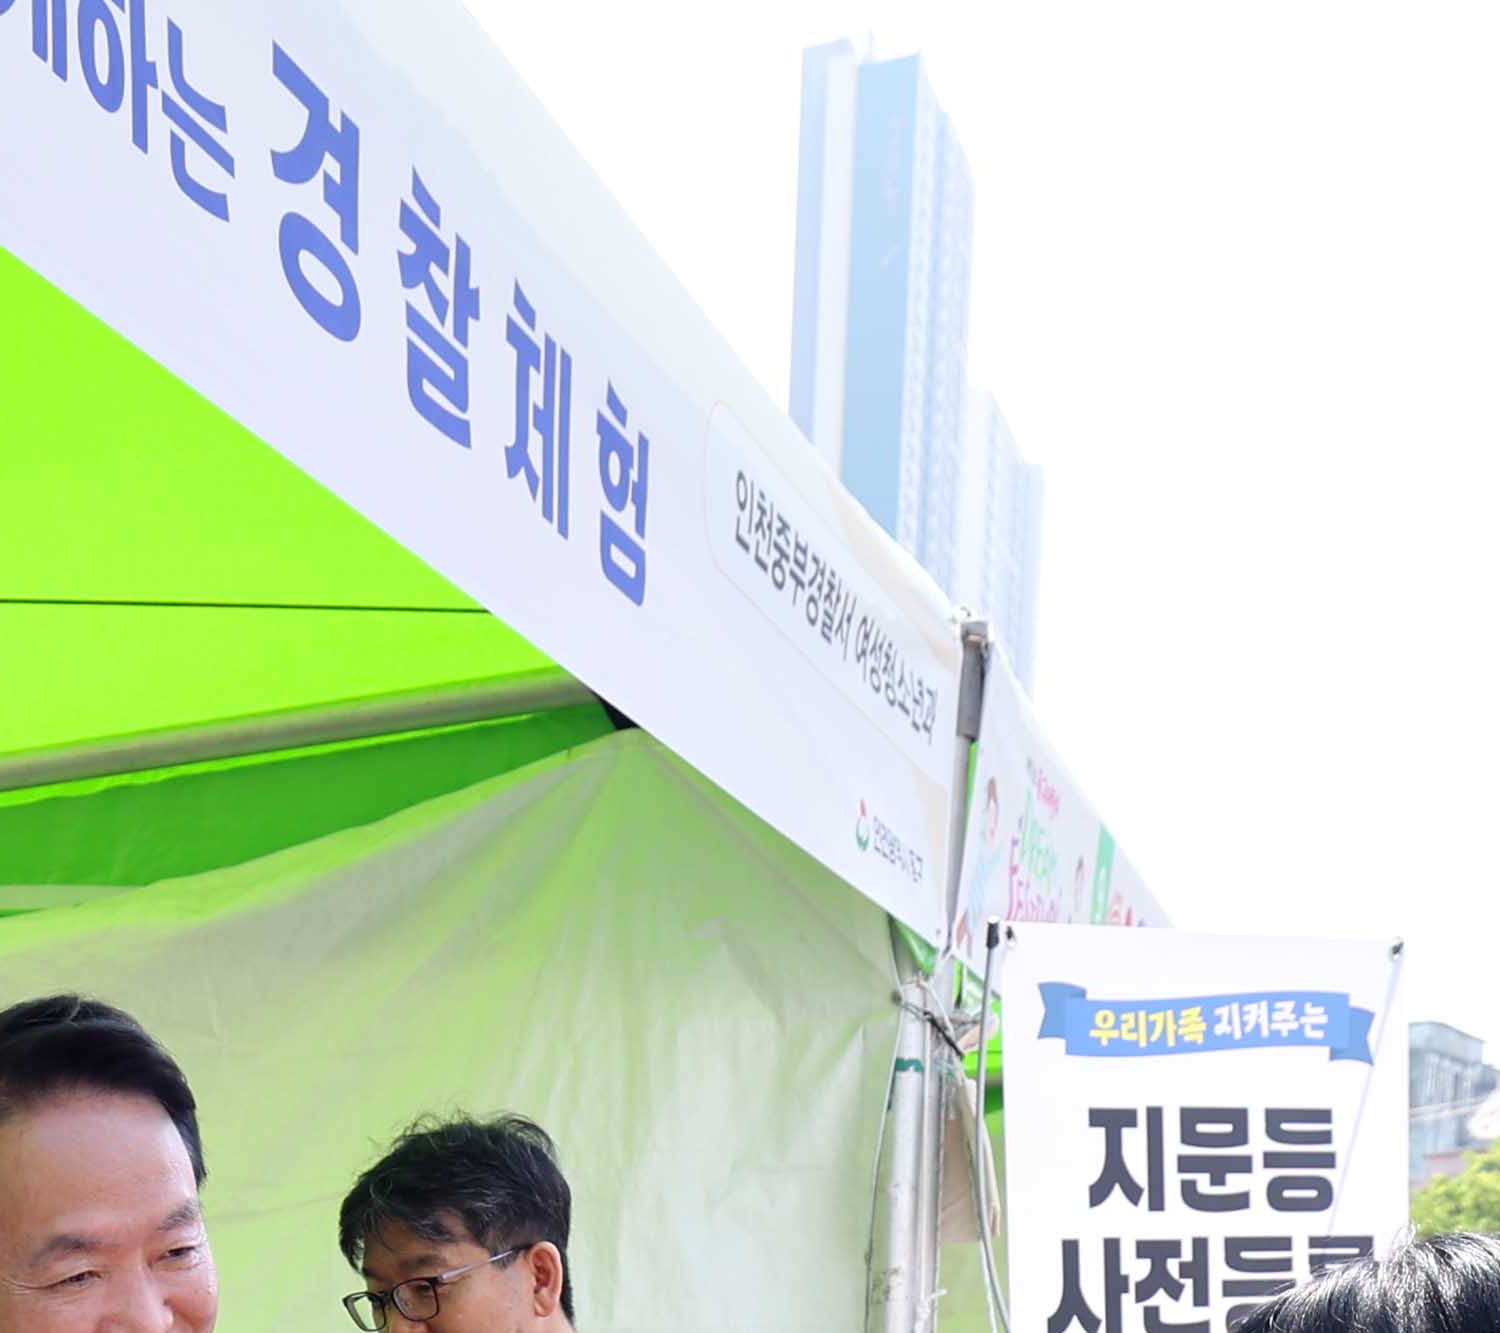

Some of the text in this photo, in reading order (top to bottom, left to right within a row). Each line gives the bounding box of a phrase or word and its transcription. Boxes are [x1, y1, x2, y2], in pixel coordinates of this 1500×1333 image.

[735, 469, 857, 662] 인천중부경찰서
[1090, 1000, 1329, 1047] 우리가족 지켜주는
[1088, 1106, 1336, 1212] 지문등
